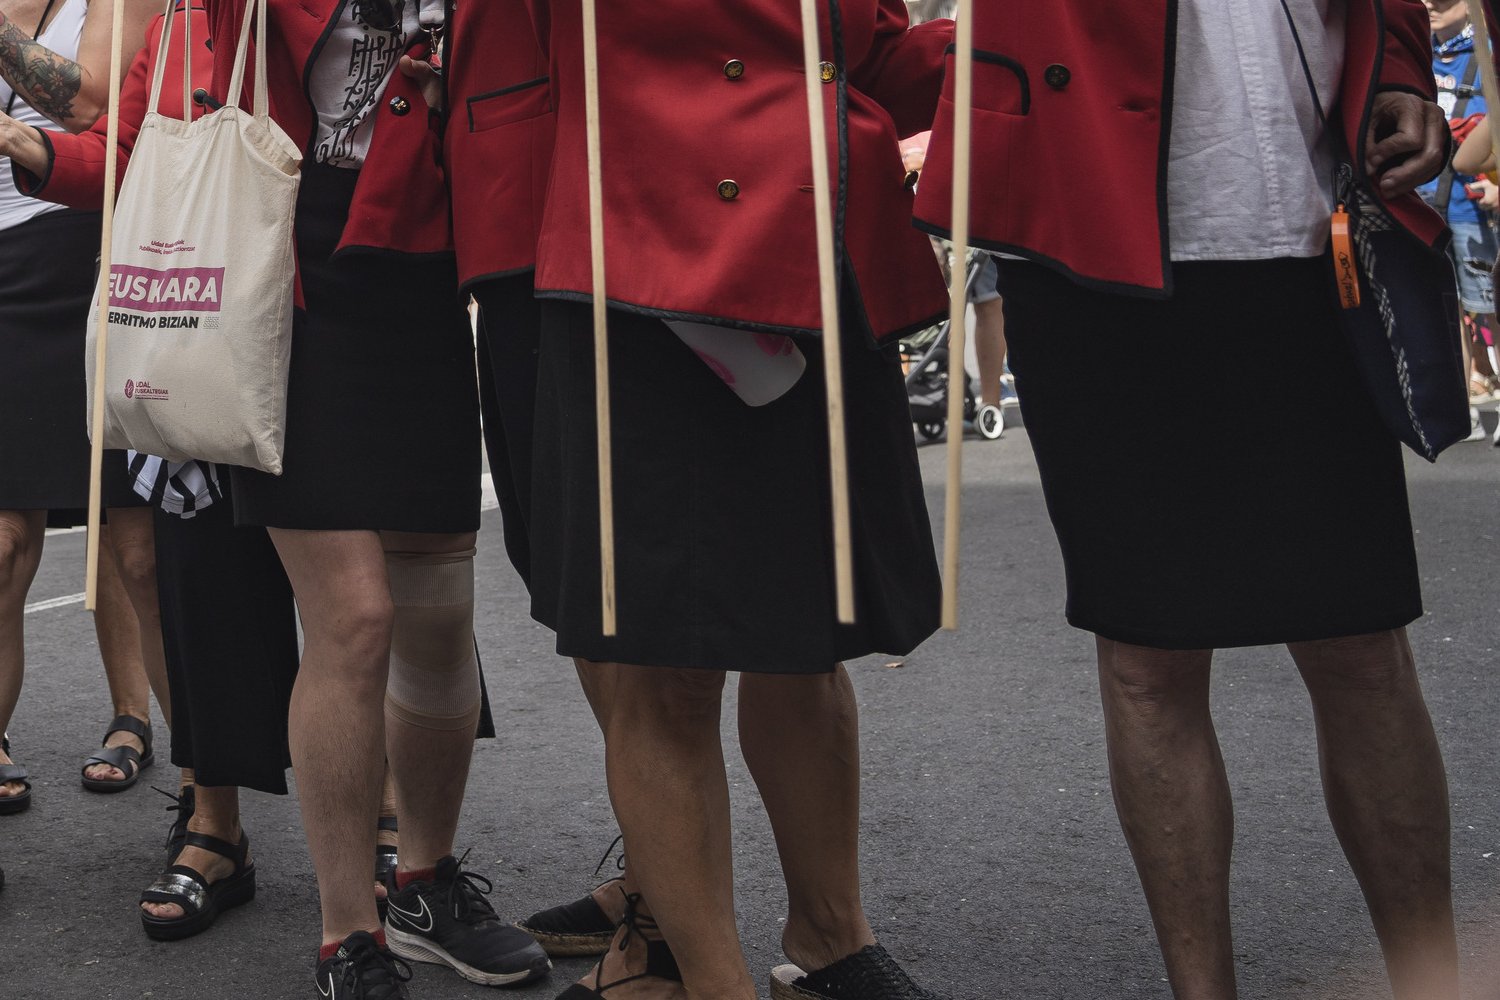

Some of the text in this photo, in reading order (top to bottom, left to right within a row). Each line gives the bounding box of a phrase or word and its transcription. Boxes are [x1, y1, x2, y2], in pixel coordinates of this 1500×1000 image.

[107, 273, 218, 303] EUSKARA
[108, 312, 198, 329] ERRITMO BIZIAN
